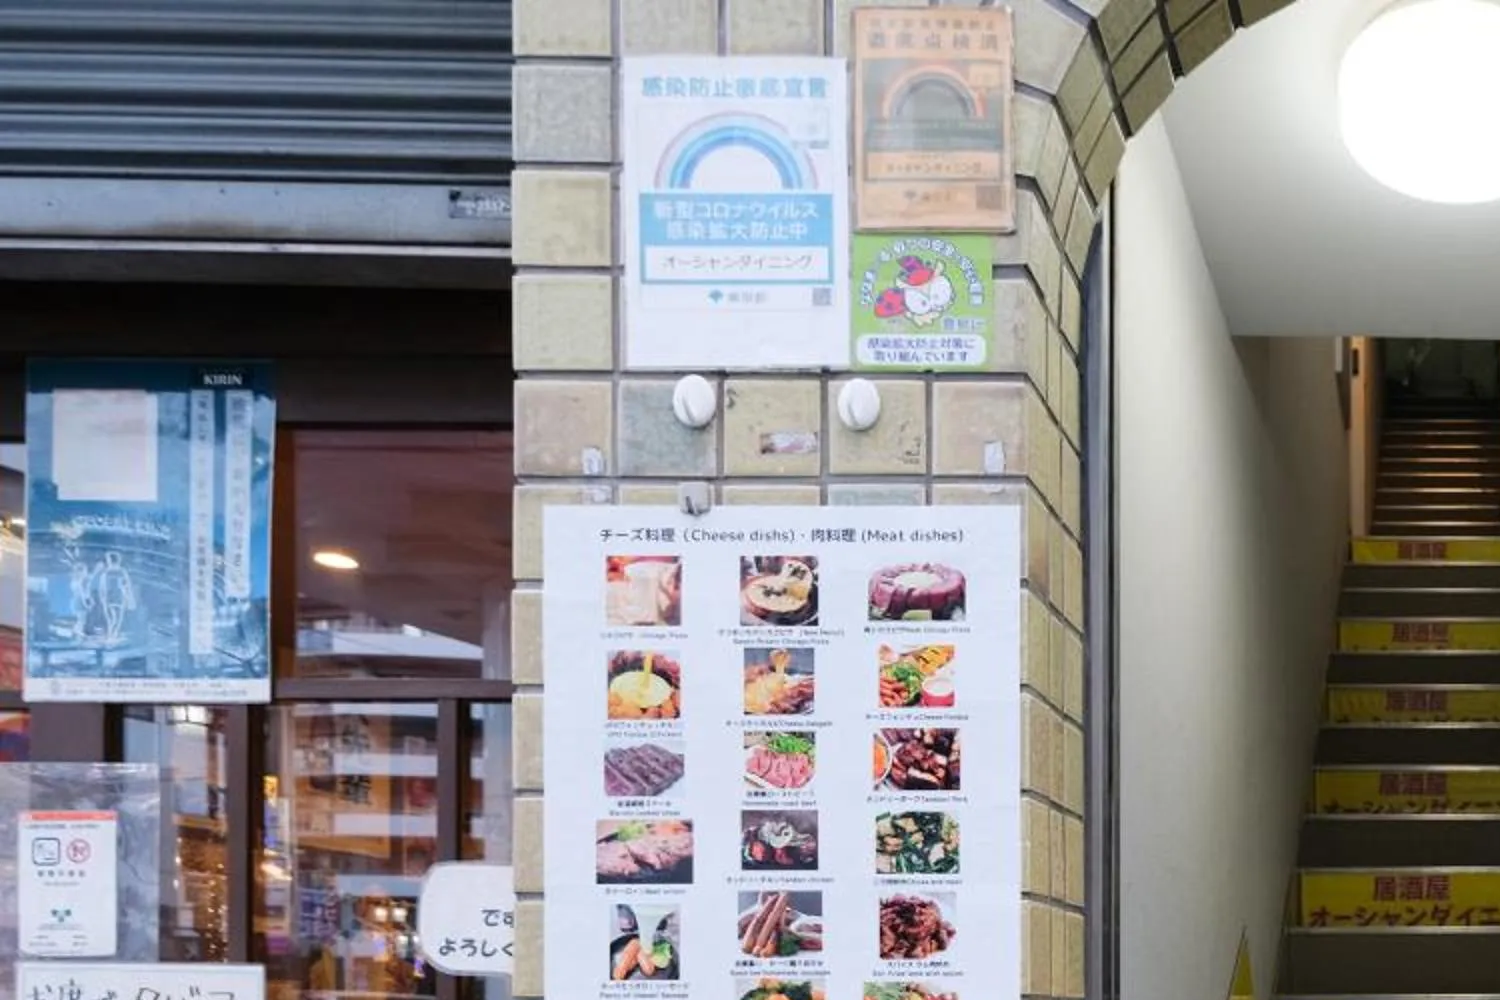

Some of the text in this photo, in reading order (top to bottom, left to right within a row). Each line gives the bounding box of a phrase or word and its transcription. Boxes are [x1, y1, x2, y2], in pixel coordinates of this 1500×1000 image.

[641, 77, 826, 98] 感染防止徹底宣言
[655, 201, 819, 220] 新型コロナウイルス
[666, 222, 808, 240] 感染拡大防止中
[662, 255, 814, 271] オーシャンダイニング
[873, 350, 968, 363] 取り組んでいます
[203, 374, 243, 385] KIRIN
[1373, 876, 1449, 902] 居酒屋
[438, 938, 514, 957] よろしく
